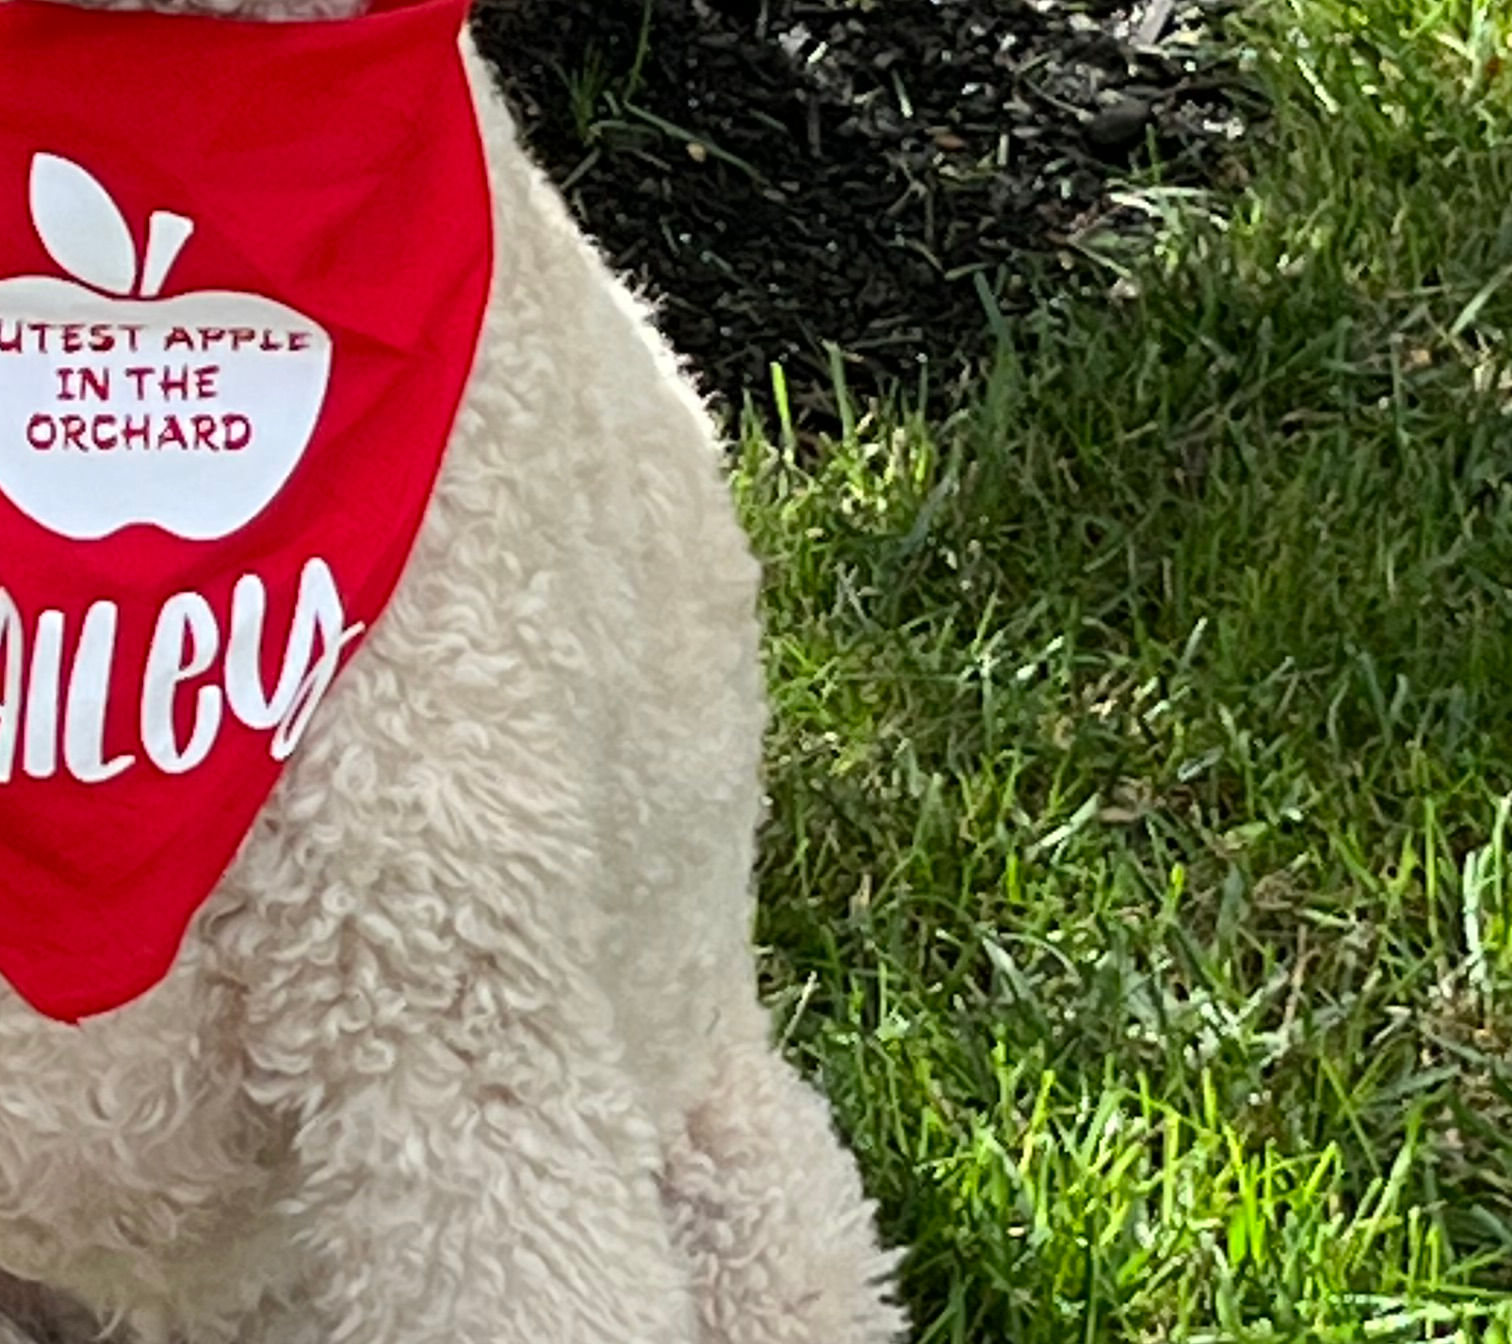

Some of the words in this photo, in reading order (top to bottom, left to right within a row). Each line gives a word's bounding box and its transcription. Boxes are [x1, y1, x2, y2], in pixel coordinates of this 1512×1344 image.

[163, 325, 312, 352] APPLE
[55, 366, 110, 401] IN
[125, 365, 220, 401] THE
[26, 412, 252, 452] ORCHARD
